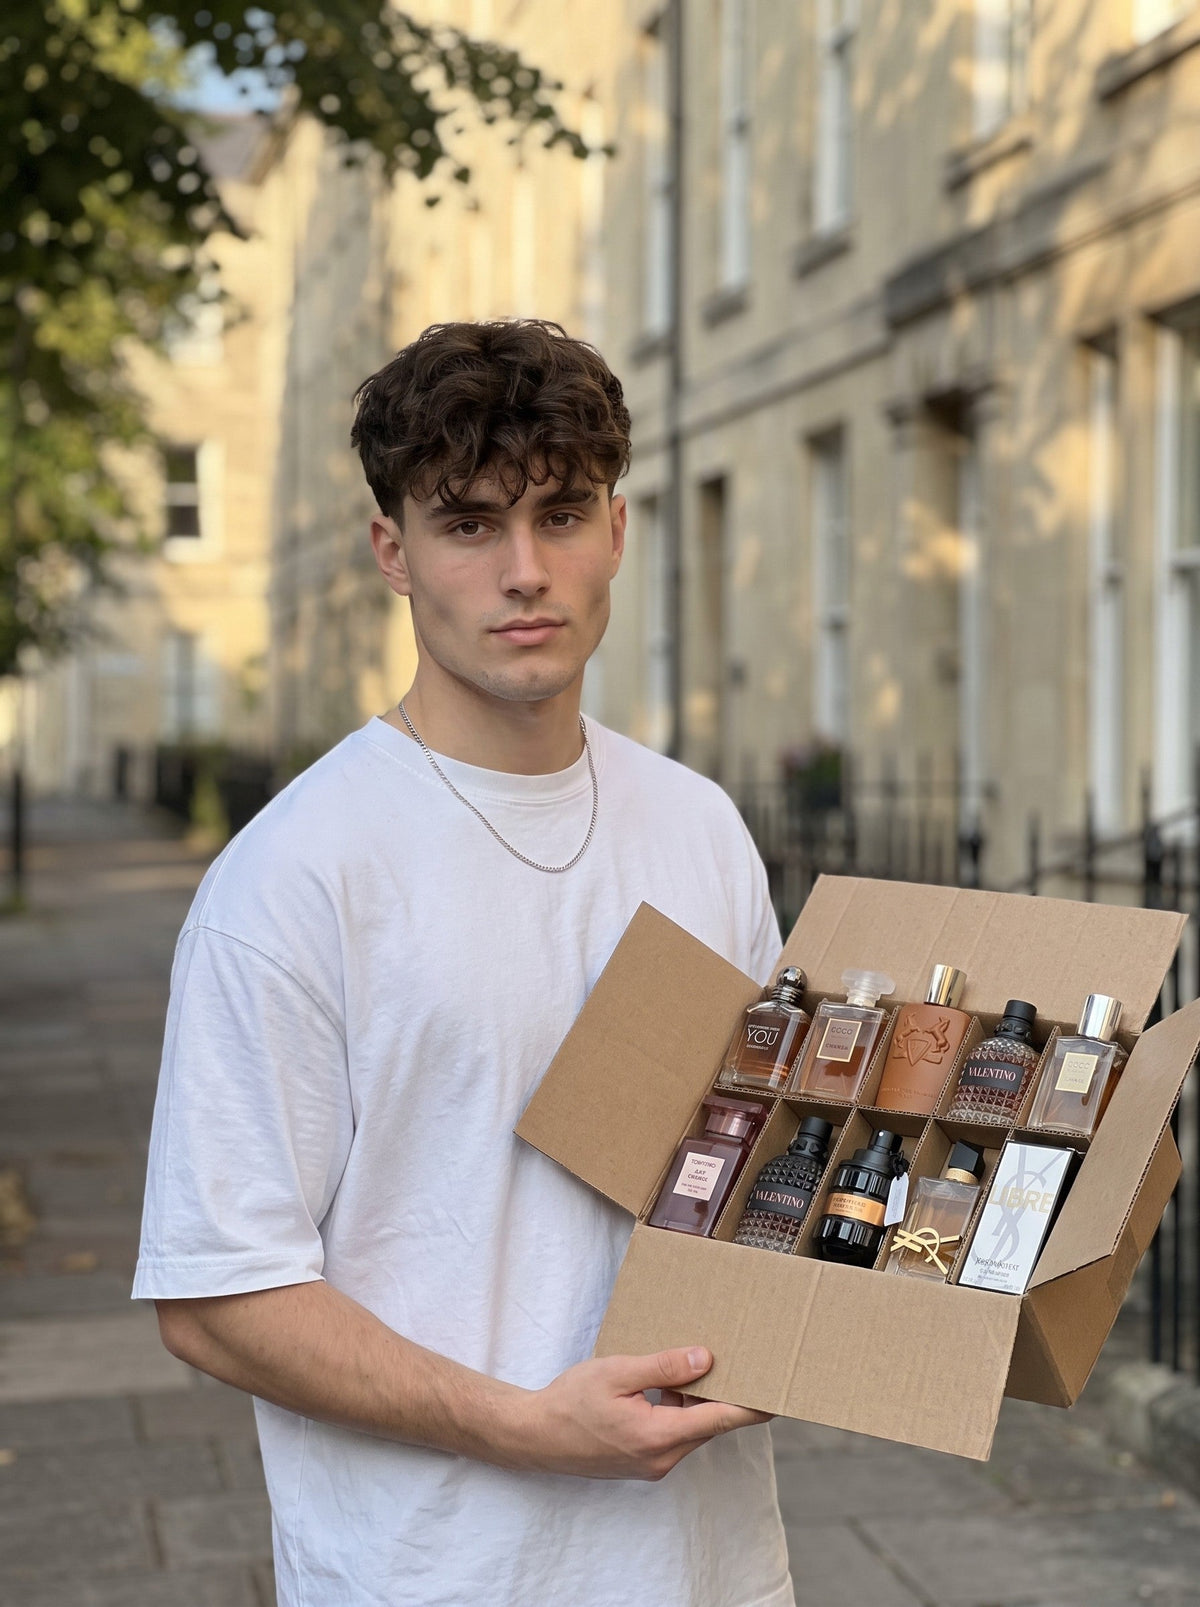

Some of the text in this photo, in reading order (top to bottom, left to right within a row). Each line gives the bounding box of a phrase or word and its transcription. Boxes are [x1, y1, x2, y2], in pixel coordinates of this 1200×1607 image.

[747, 1028, 779, 1046] YOU
[969, 1066, 1016, 1082] VALENTINO
[755, 1190, 805, 1209] VALENTINO
[988, 1184, 1055, 1214] LIBRE
